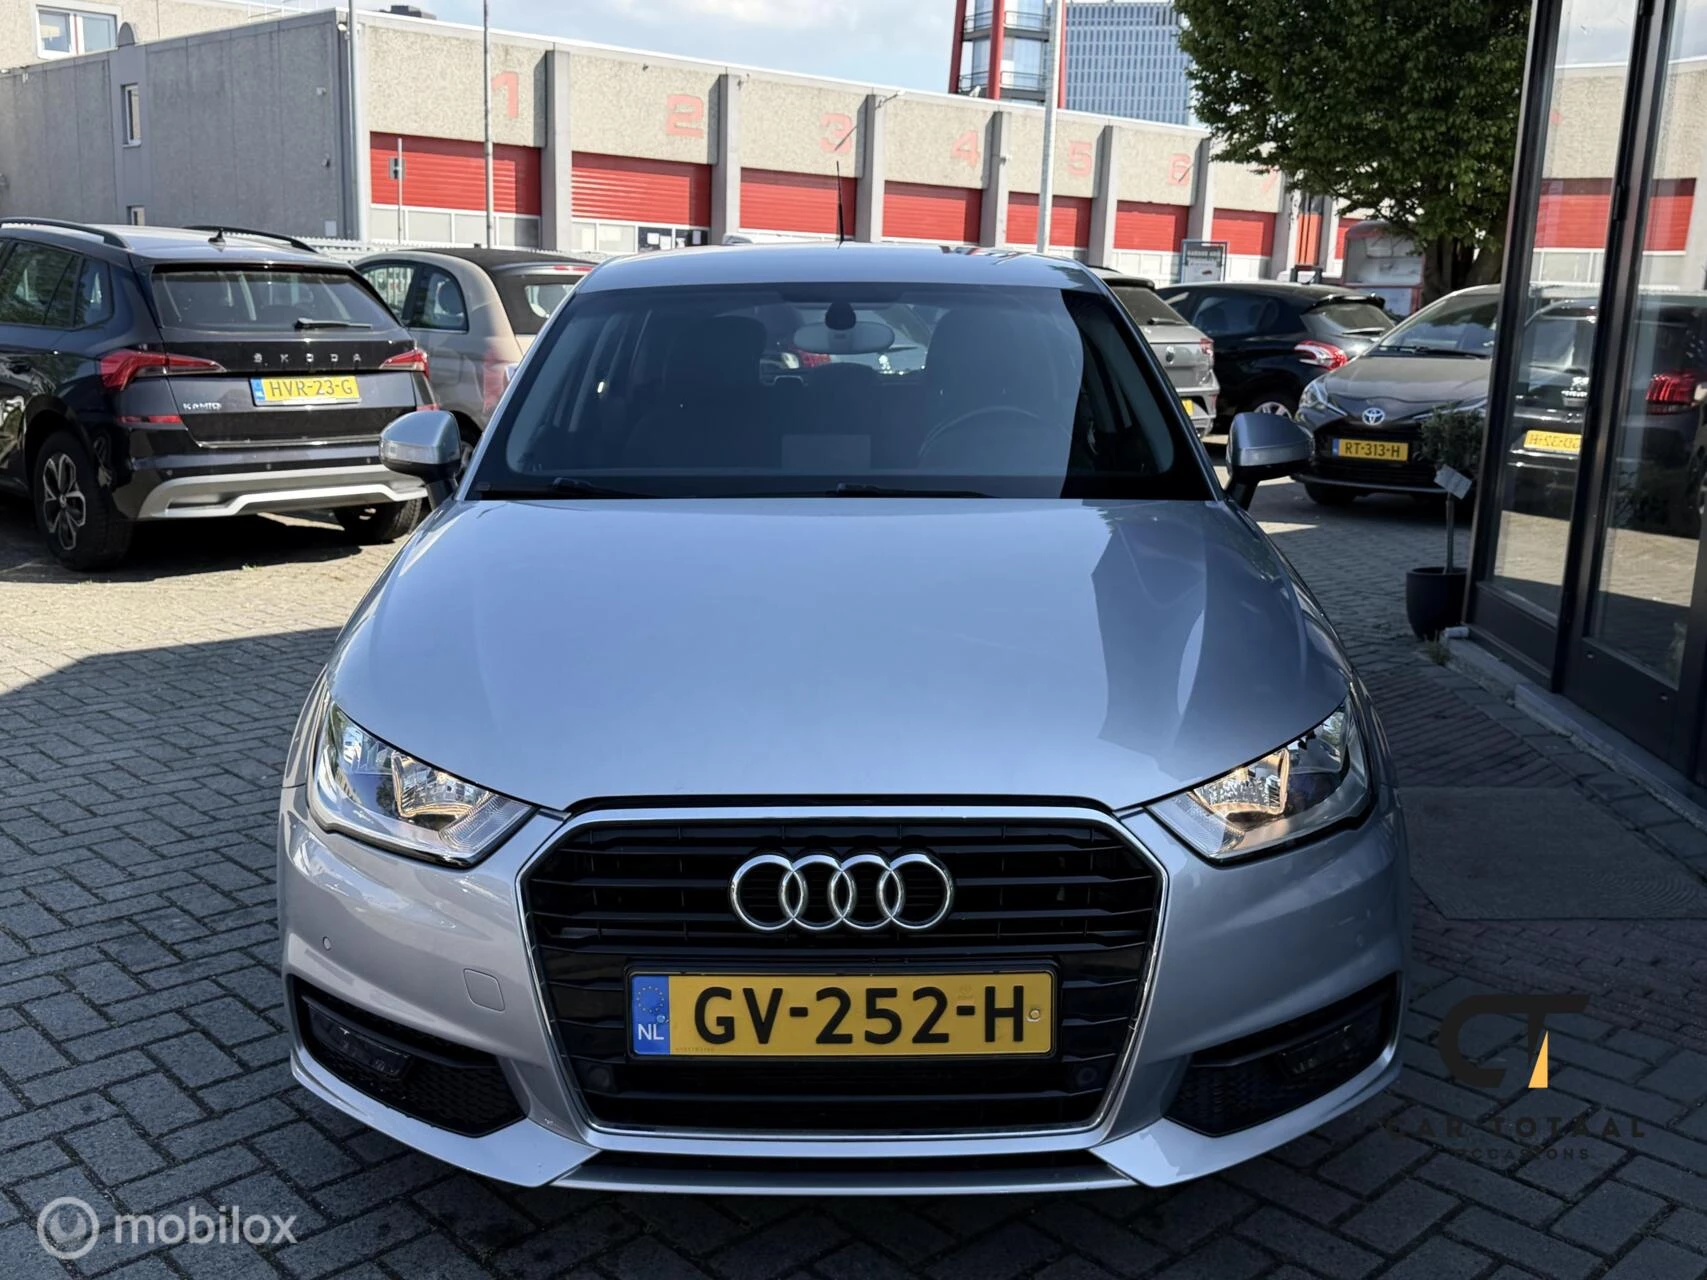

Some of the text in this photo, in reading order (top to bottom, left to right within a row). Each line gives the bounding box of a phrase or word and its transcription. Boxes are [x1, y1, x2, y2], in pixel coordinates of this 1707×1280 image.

[490, 71, 519, 119] 1
[665, 94, 704, 138] 2
[819, 113, 852, 153] 3
[950, 130, 980, 169] 4
[1066, 141, 1093, 177] 5
[1167, 153, 1191, 186] 6
[270, 379, 353, 397] HVR-23-G
[1344, 441, 1400, 458] RT-313-H
[638, 1024, 664, 1041] NL
[694, 985, 1025, 1045] GV-252-H
